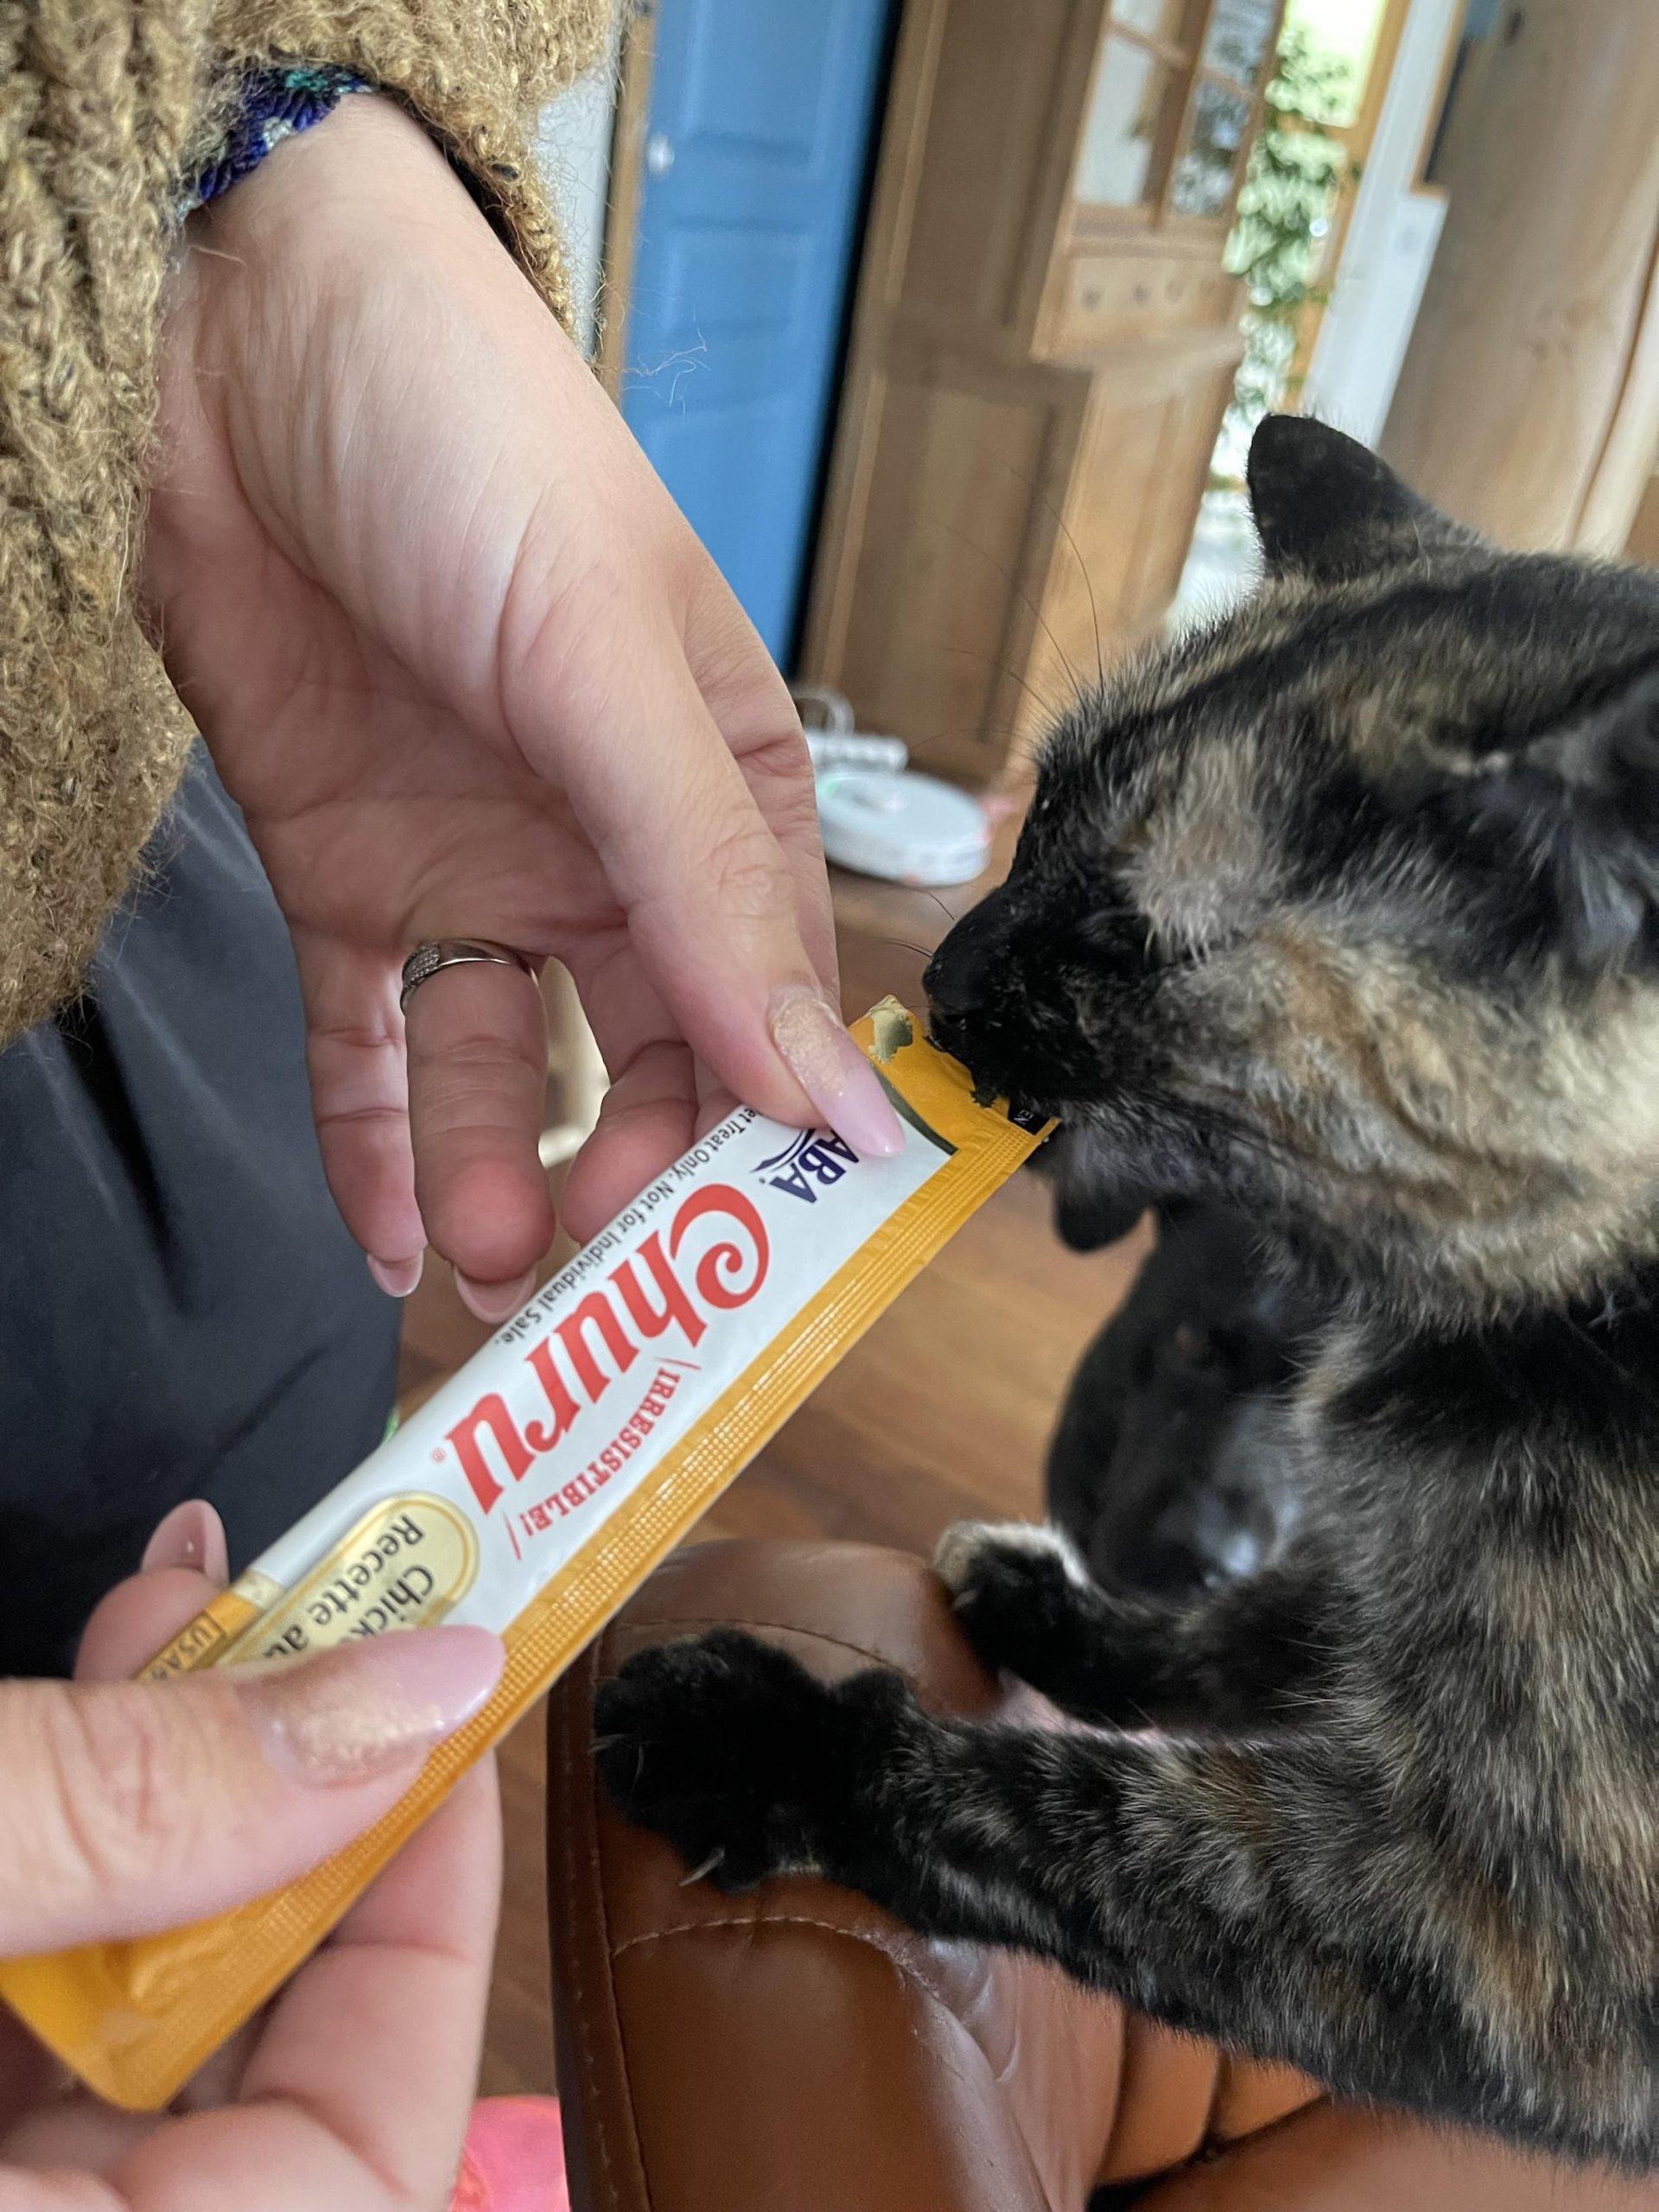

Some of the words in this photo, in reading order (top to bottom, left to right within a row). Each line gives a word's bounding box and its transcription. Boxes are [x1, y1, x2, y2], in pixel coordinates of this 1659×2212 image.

[704, 1121, 746, 1152] Treat
[667, 1148, 710, 1180] Only.
[639, 1180, 675, 1211] Not
[616, 1208, 646, 1233] for
[537, 1230, 622, 1312] Individual
[495, 1306, 542, 1344] Sale.
[445, 1183, 770, 1515] Churu
[520, 1368, 682, 1537] IRRESISTIBLE!
[307, 1514, 424, 1626] Recette
